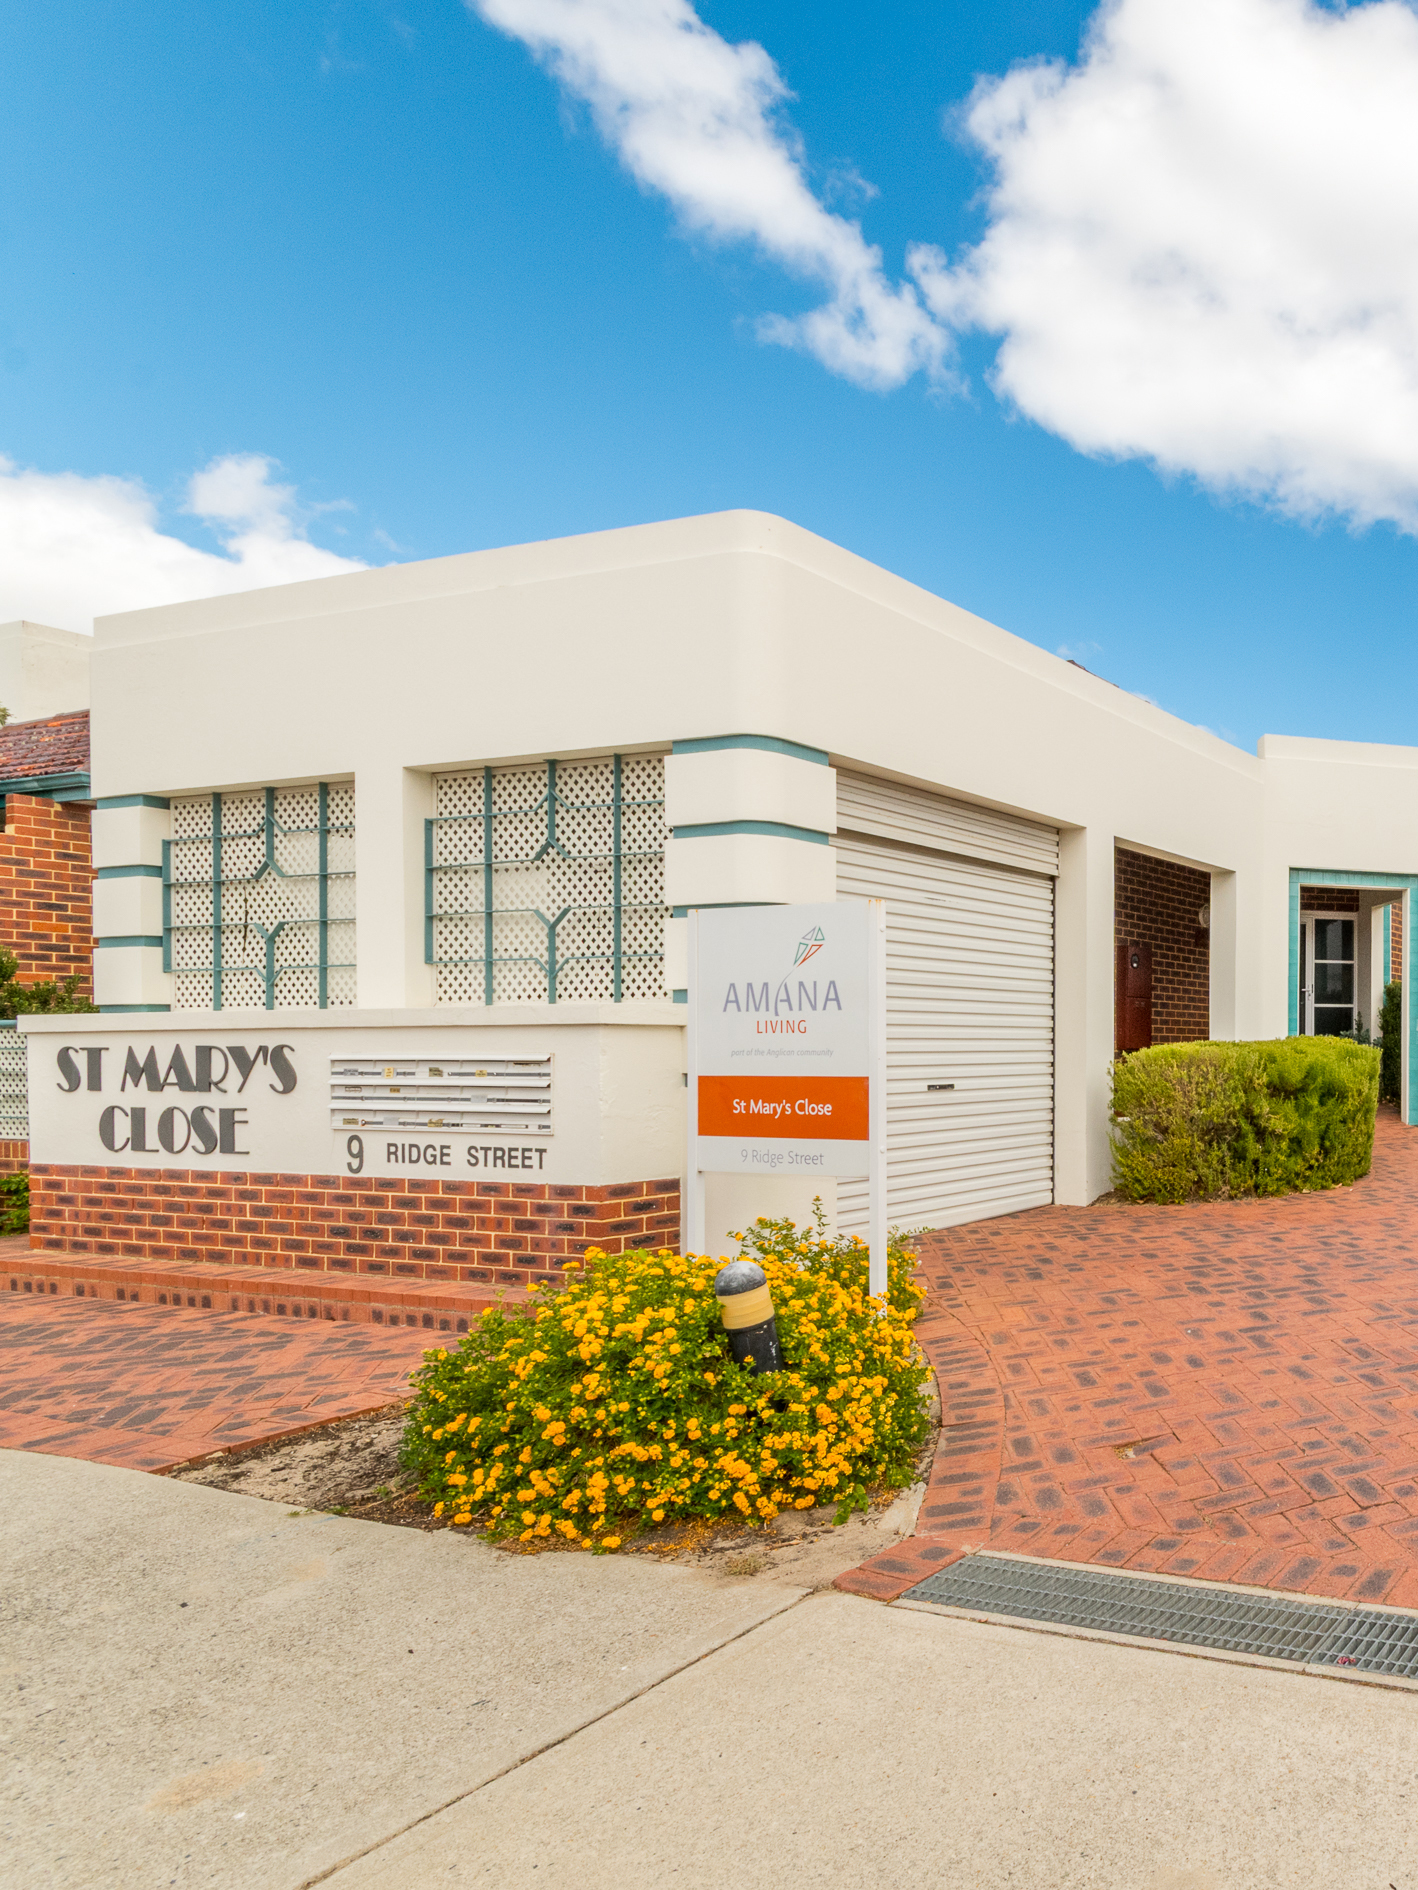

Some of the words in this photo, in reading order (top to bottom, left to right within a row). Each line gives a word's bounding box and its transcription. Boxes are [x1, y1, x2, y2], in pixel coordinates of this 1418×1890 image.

[722, 980, 843, 1017] AMANA
[756, 1019, 807, 1034] LIVING
[730, 1049, 745, 1058] part
[746, 1048, 754, 1057] of
[754, 1048, 765, 1057] the
[766, 1048, 795, 1059] Anglican
[796, 1048, 834, 1058] community
[57, 1046, 110, 1093] ST
[120, 1043, 298, 1095] MARY'S
[732, 1098, 747, 1115] St
[749, 1099, 792, 1119] Mary's
[794, 1099, 833, 1116] Close
[98, 1104, 251, 1156] CLOSE
[346, 1134, 365, 1175] 9
[386, 1142, 452, 1166] RIDGE
[466, 1145, 548, 1170] STREET
[741, 1149, 748, 1163] 9
[751, 1149, 784, 1168] Ridge
[787, 1150, 825, 1166] Street
